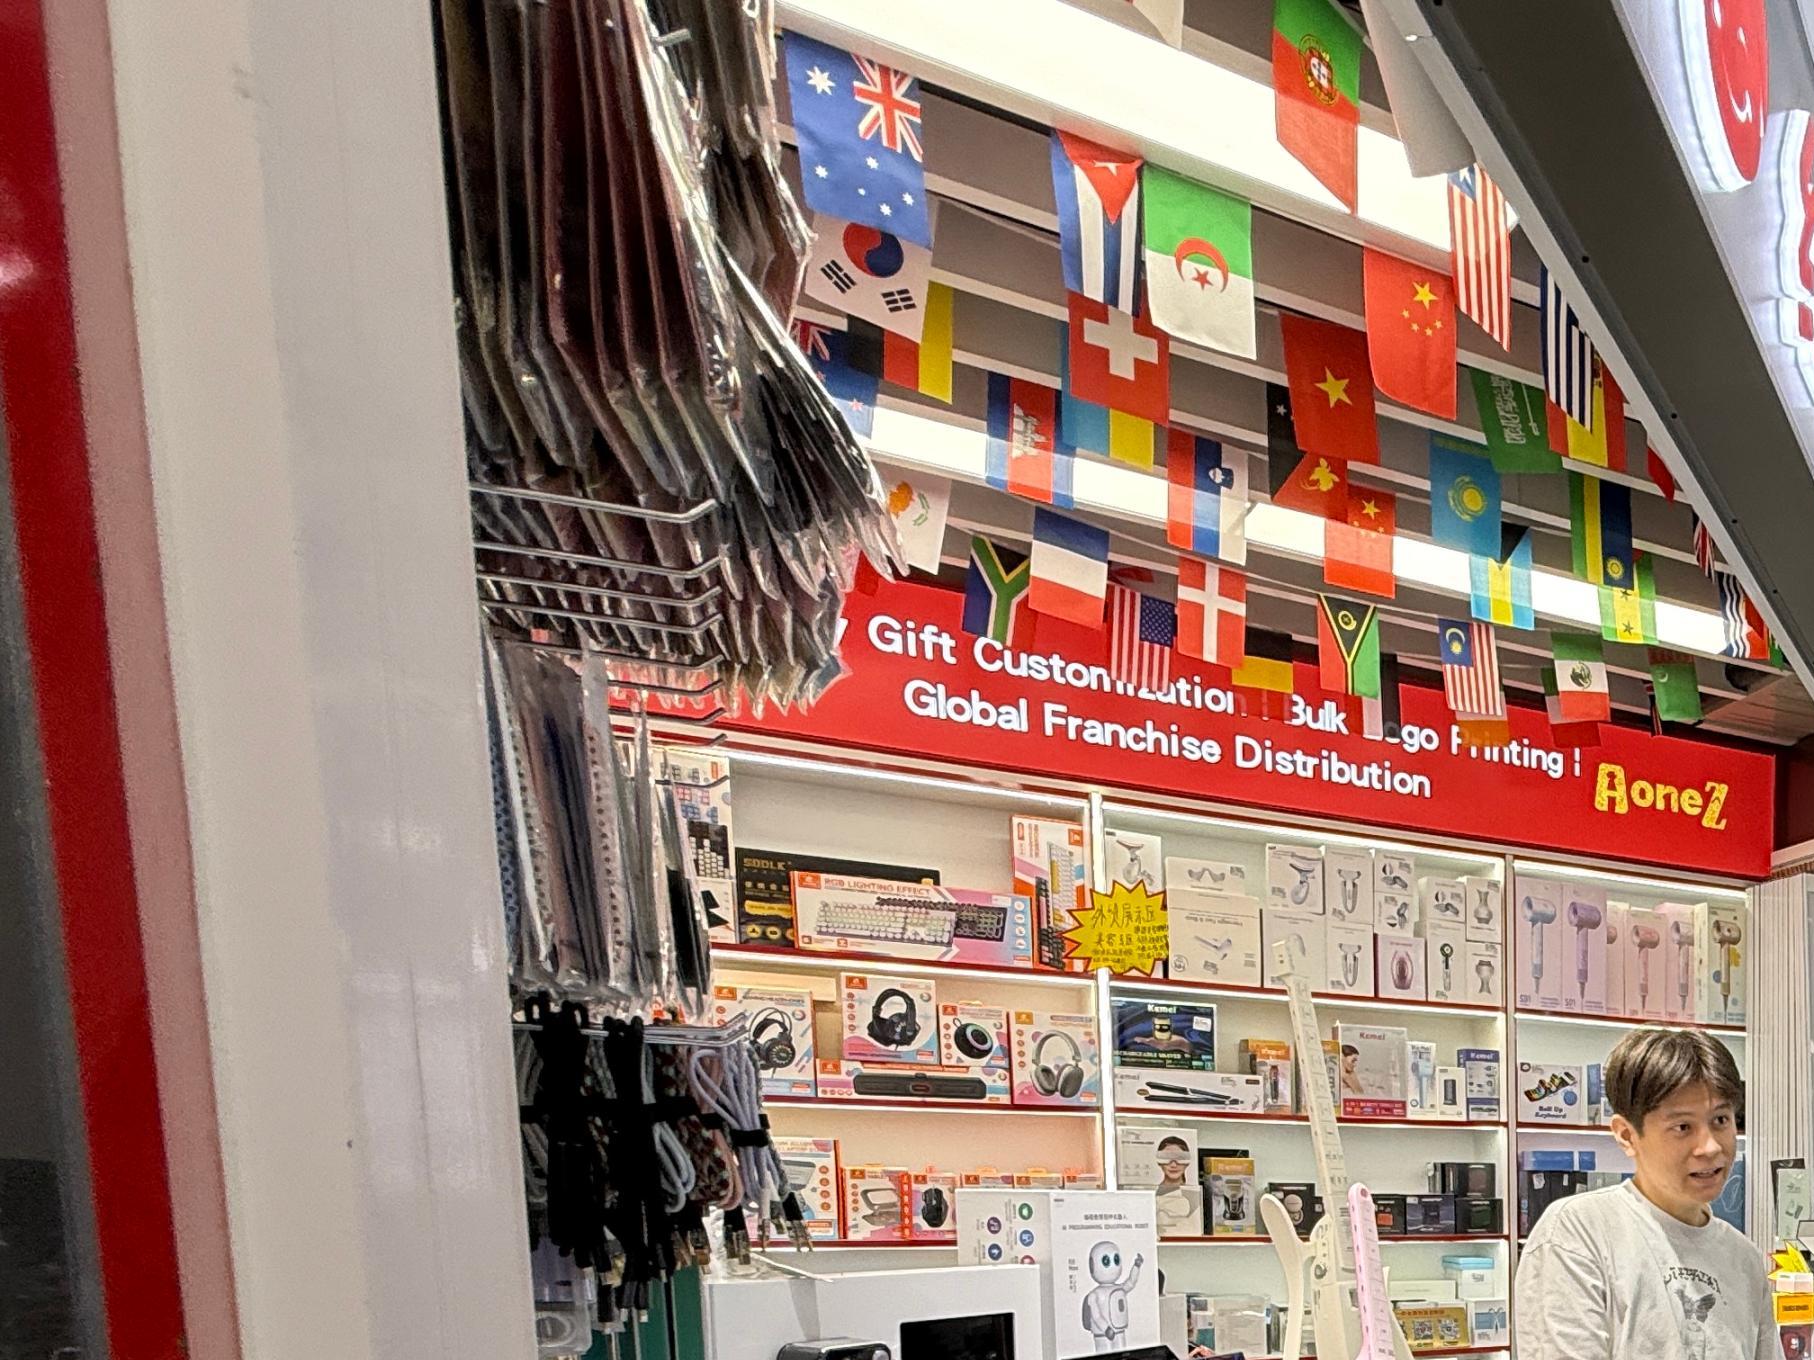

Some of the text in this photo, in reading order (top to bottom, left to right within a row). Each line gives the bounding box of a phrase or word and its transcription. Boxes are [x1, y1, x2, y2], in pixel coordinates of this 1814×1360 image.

[867, 614, 957, 665] Gift
[1286, 694, 1350, 736] Bulk
[903, 678, 1432, 799] Global Franchise Distribution
[847, 880, 895, 892] LIGHTING
[896, 884, 931, 897] EFFECT
